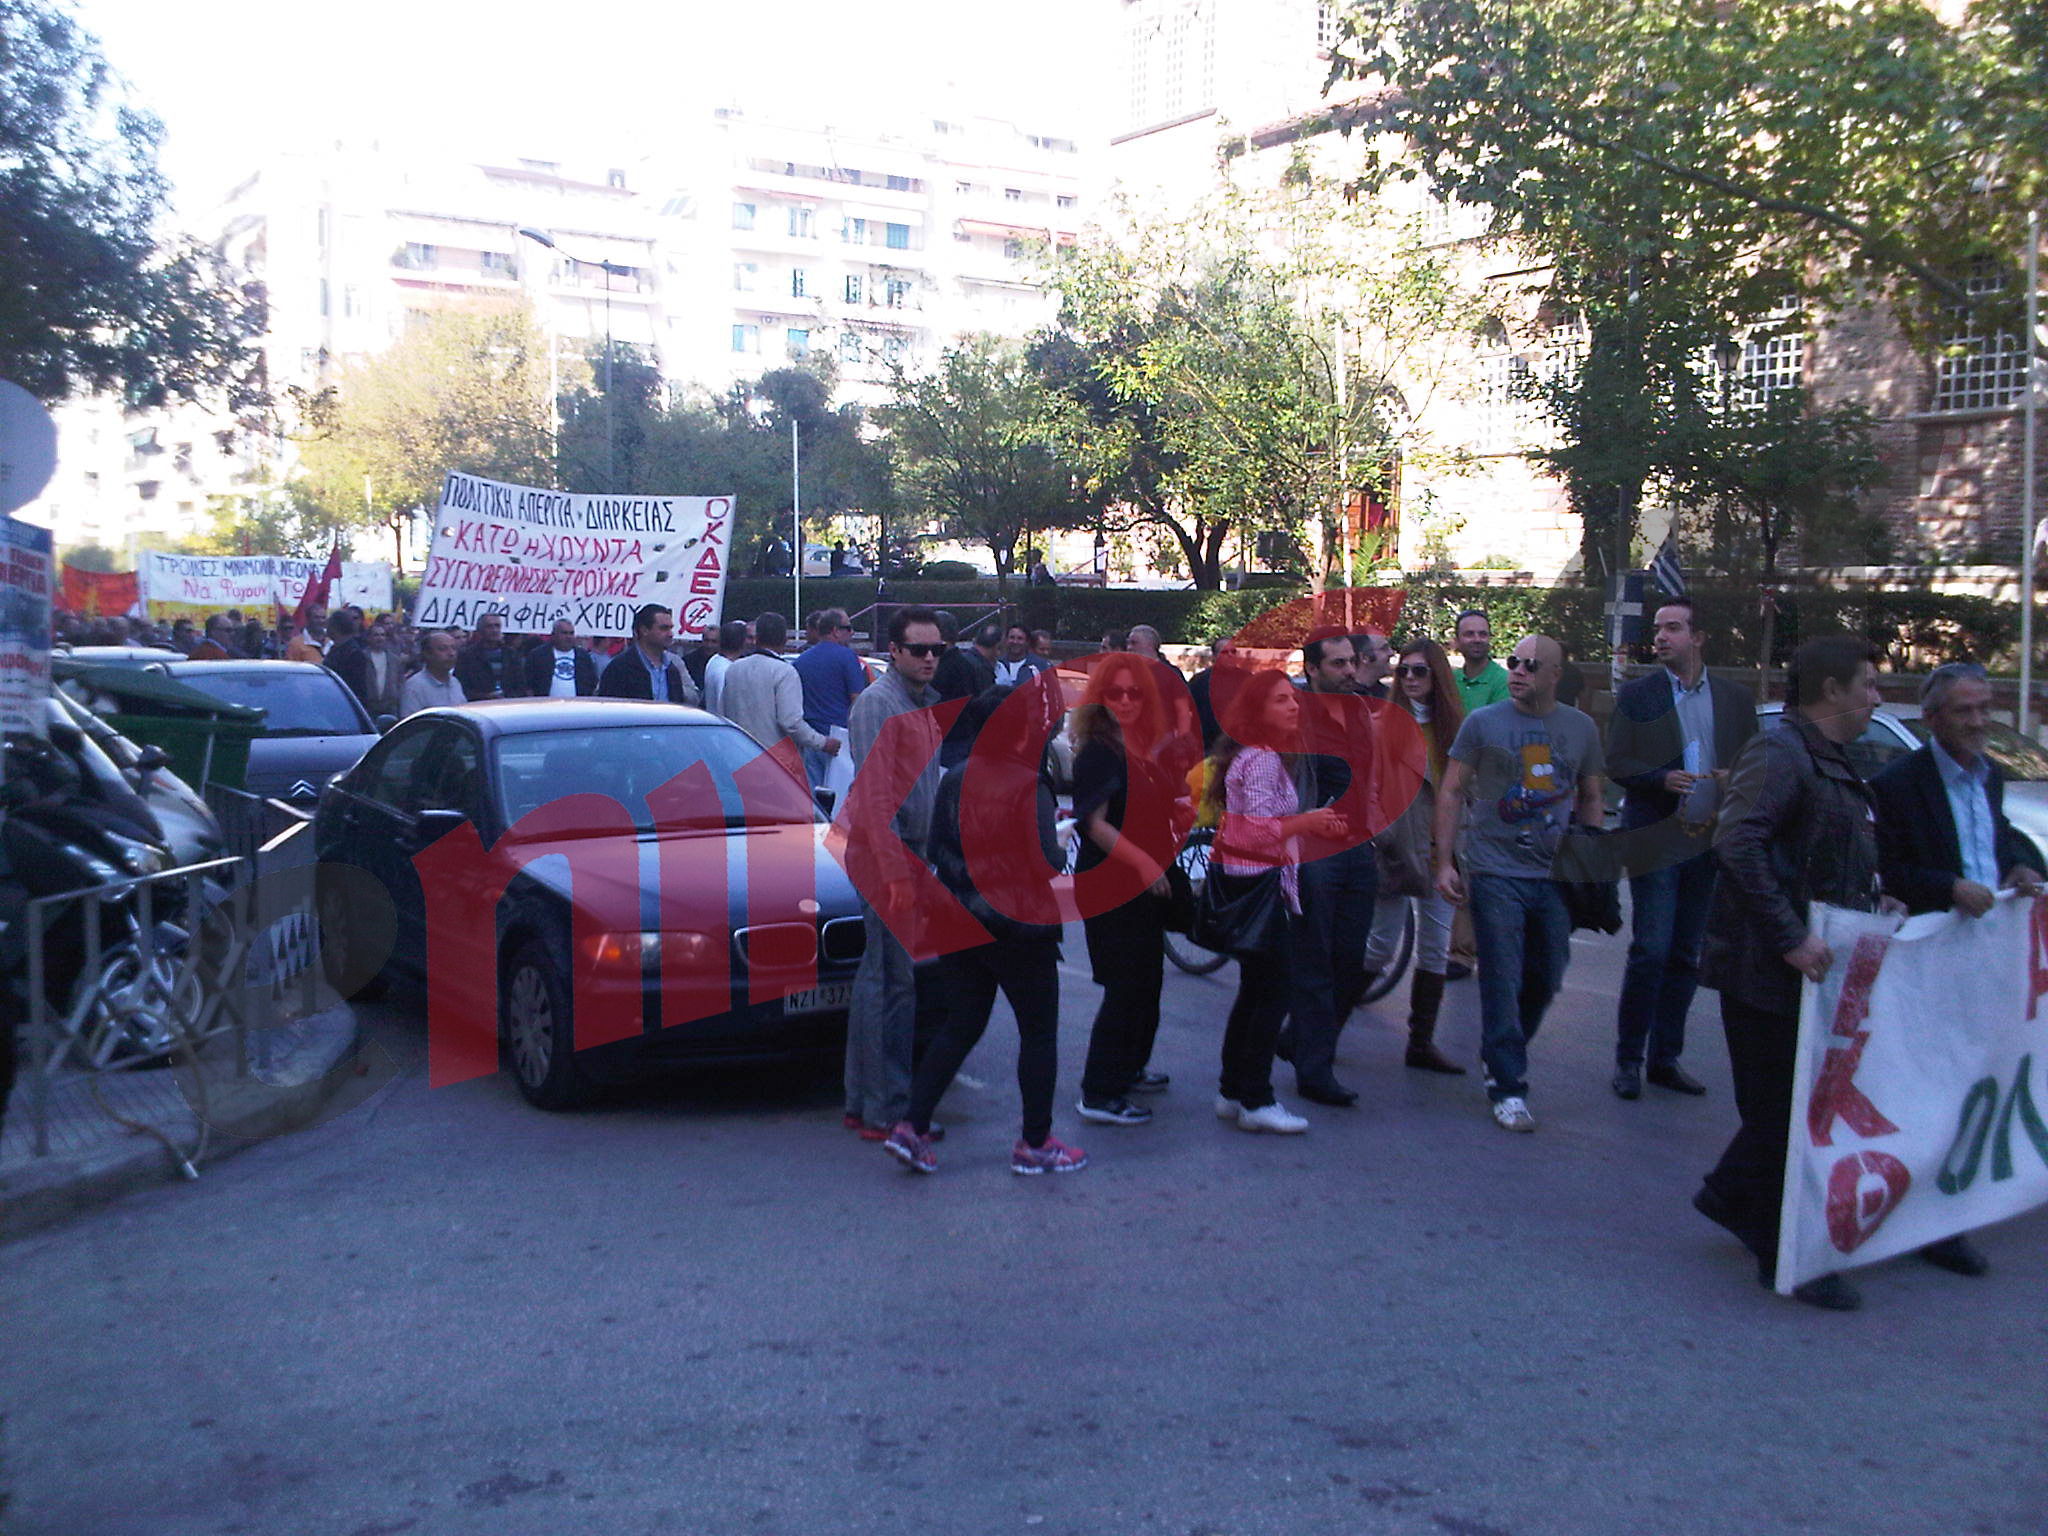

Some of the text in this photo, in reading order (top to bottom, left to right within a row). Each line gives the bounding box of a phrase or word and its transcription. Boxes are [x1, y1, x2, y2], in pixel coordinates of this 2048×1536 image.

[444, 475, 676, 533] ΠΟΛΙΤΙΚΗ ΑΠΕΡΓΙΑ ΔΙΑΡΚΕΙΑΣ
[690, 498, 730, 595] ΟΚΔΕ
